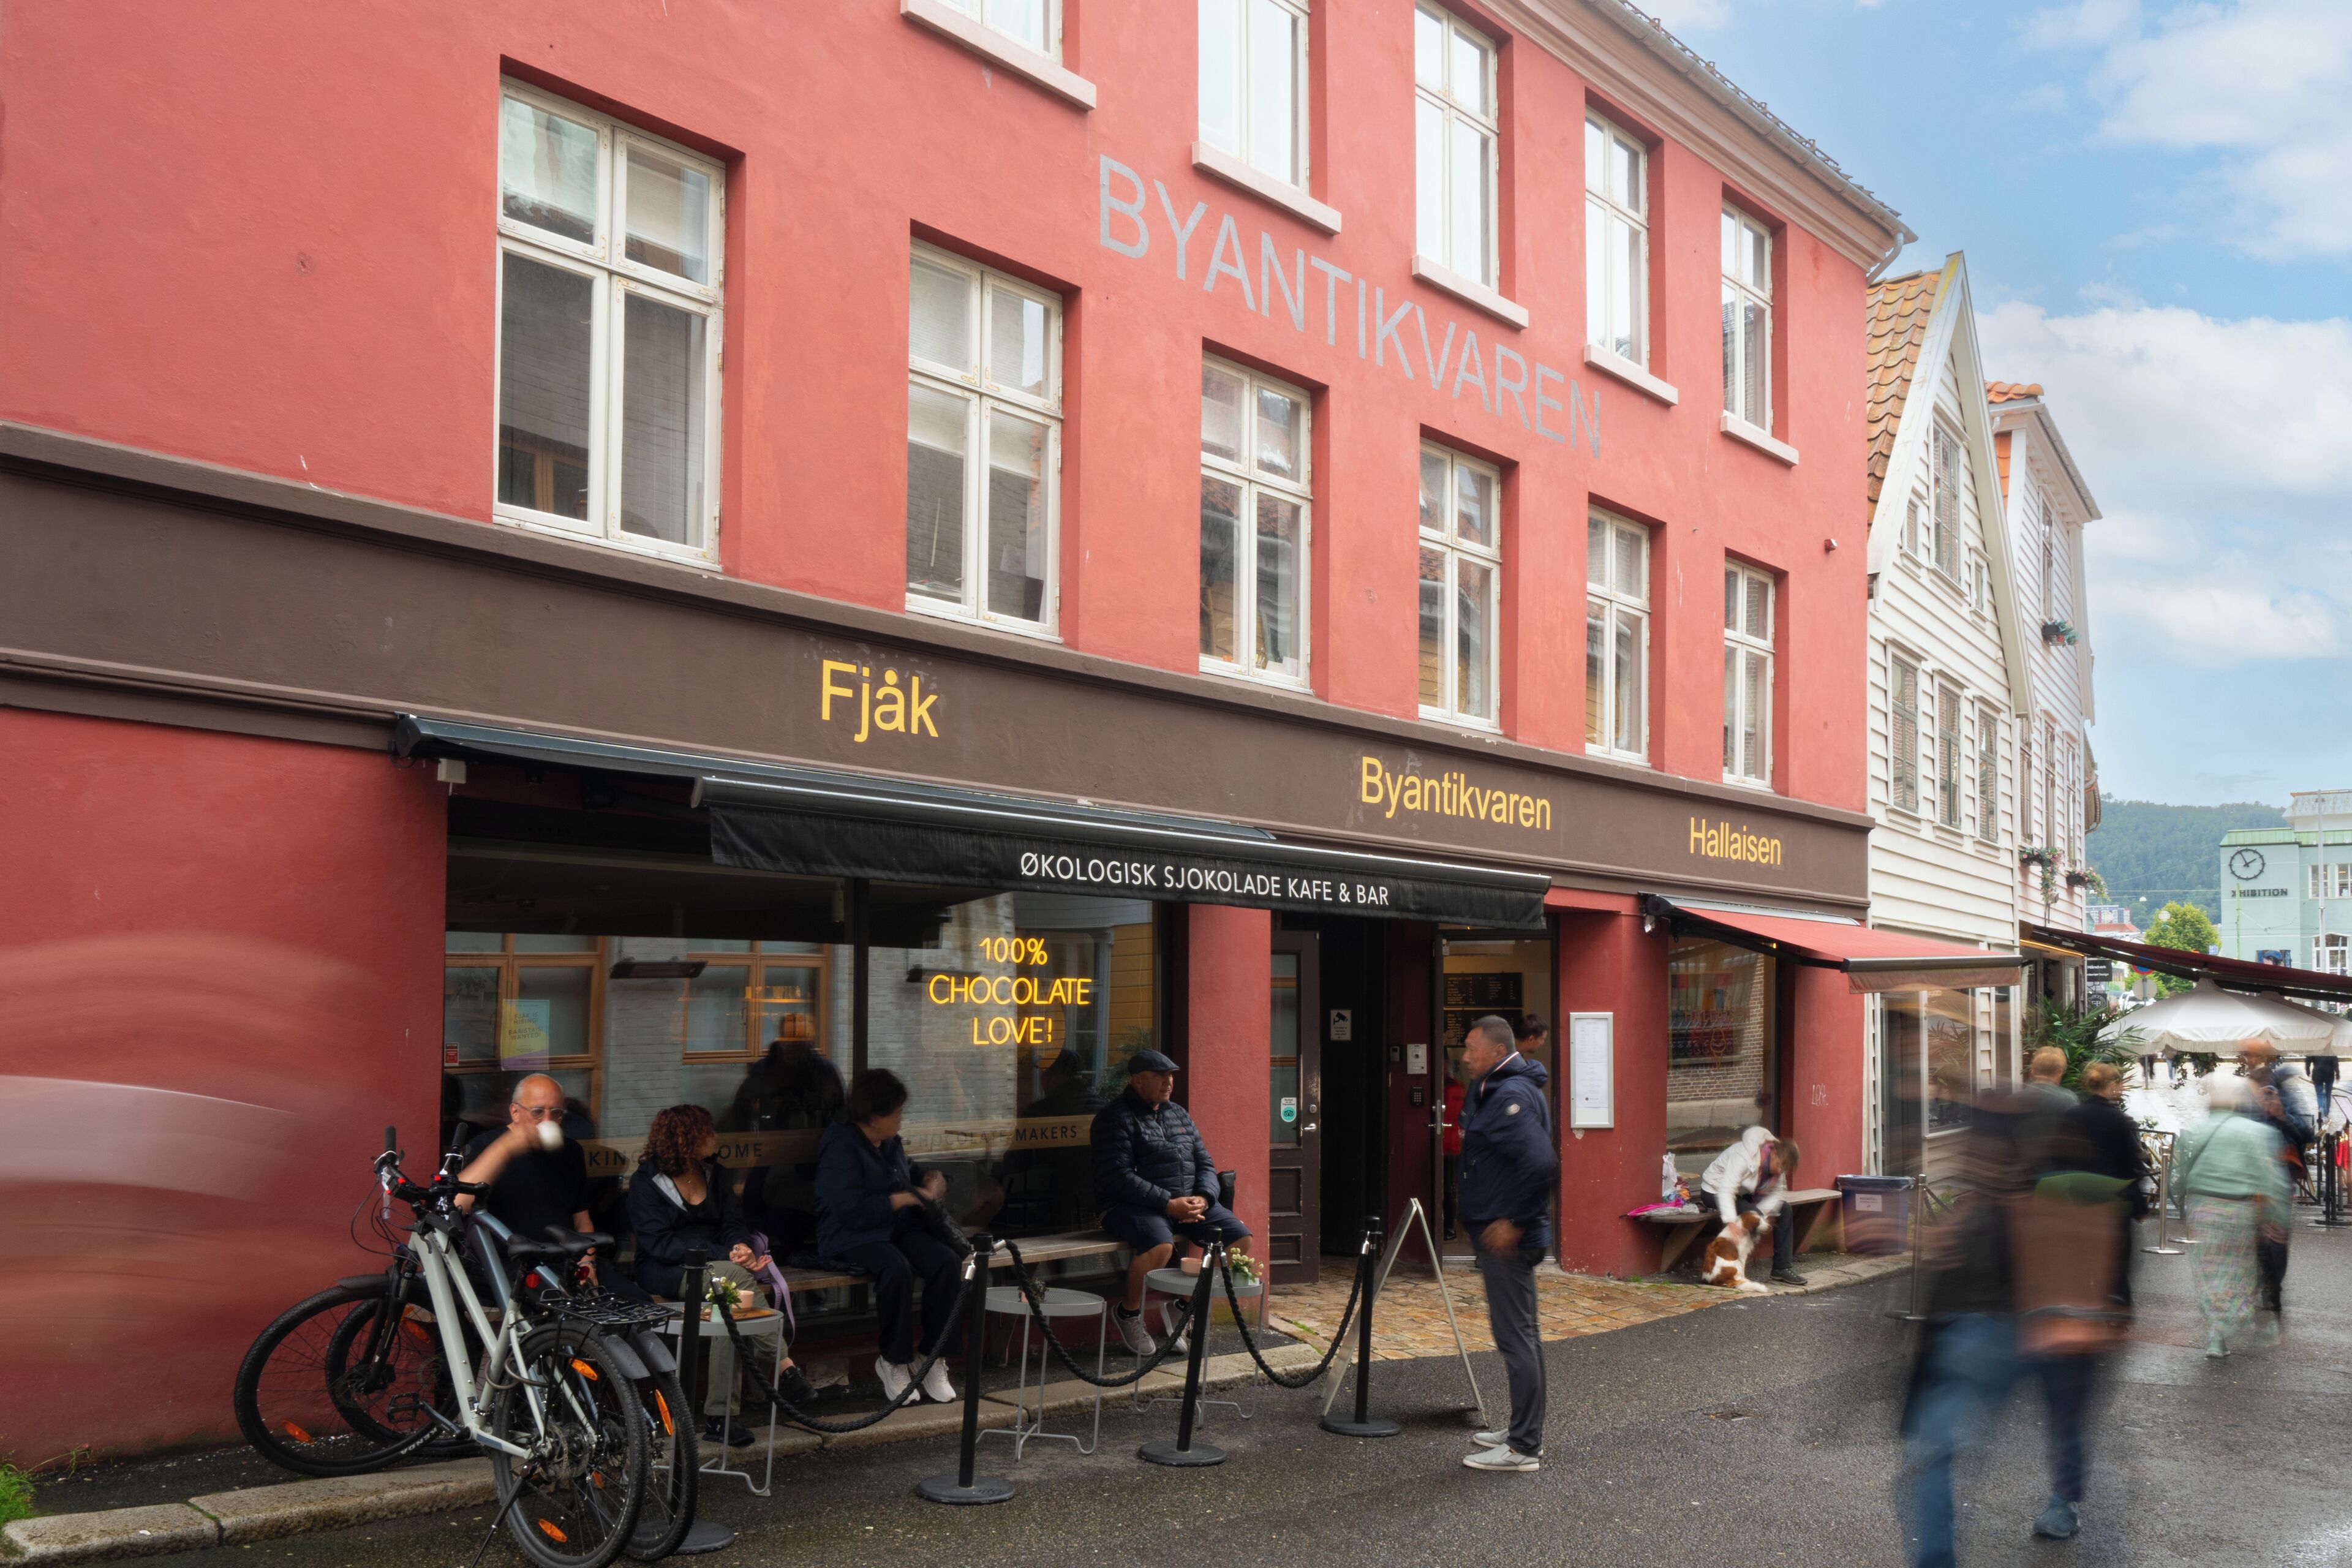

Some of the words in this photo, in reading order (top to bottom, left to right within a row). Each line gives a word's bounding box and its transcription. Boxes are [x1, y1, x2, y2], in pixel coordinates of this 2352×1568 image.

[1099, 153, 1600, 459] BYANTIKVAREN
[821, 659, 939, 743] Fjåk
[1361, 756, 1551, 831] Byantikvaren
[1689, 816, 1782, 865] Hallaisen
[1020, 851, 1157, 886] ØKOLOGISK
[1164, 865, 1281, 897] SJOKOLADE
[1287, 878, 1333, 902] KAFE
[1338, 883, 1351, 903] &
[1356, 884, 1389, 905] BAR
[2231, 888, 2288, 897] XHIBITION
[979, 937, 1049, 966] 100%
[929, 974, 1092, 1006] CHOCOLATE
[972, 1016, 1052, 1046] LOVE!
[1015, 1125, 1077, 1142] MAKERS
[400, 1426, 438, 1455] KENDA
